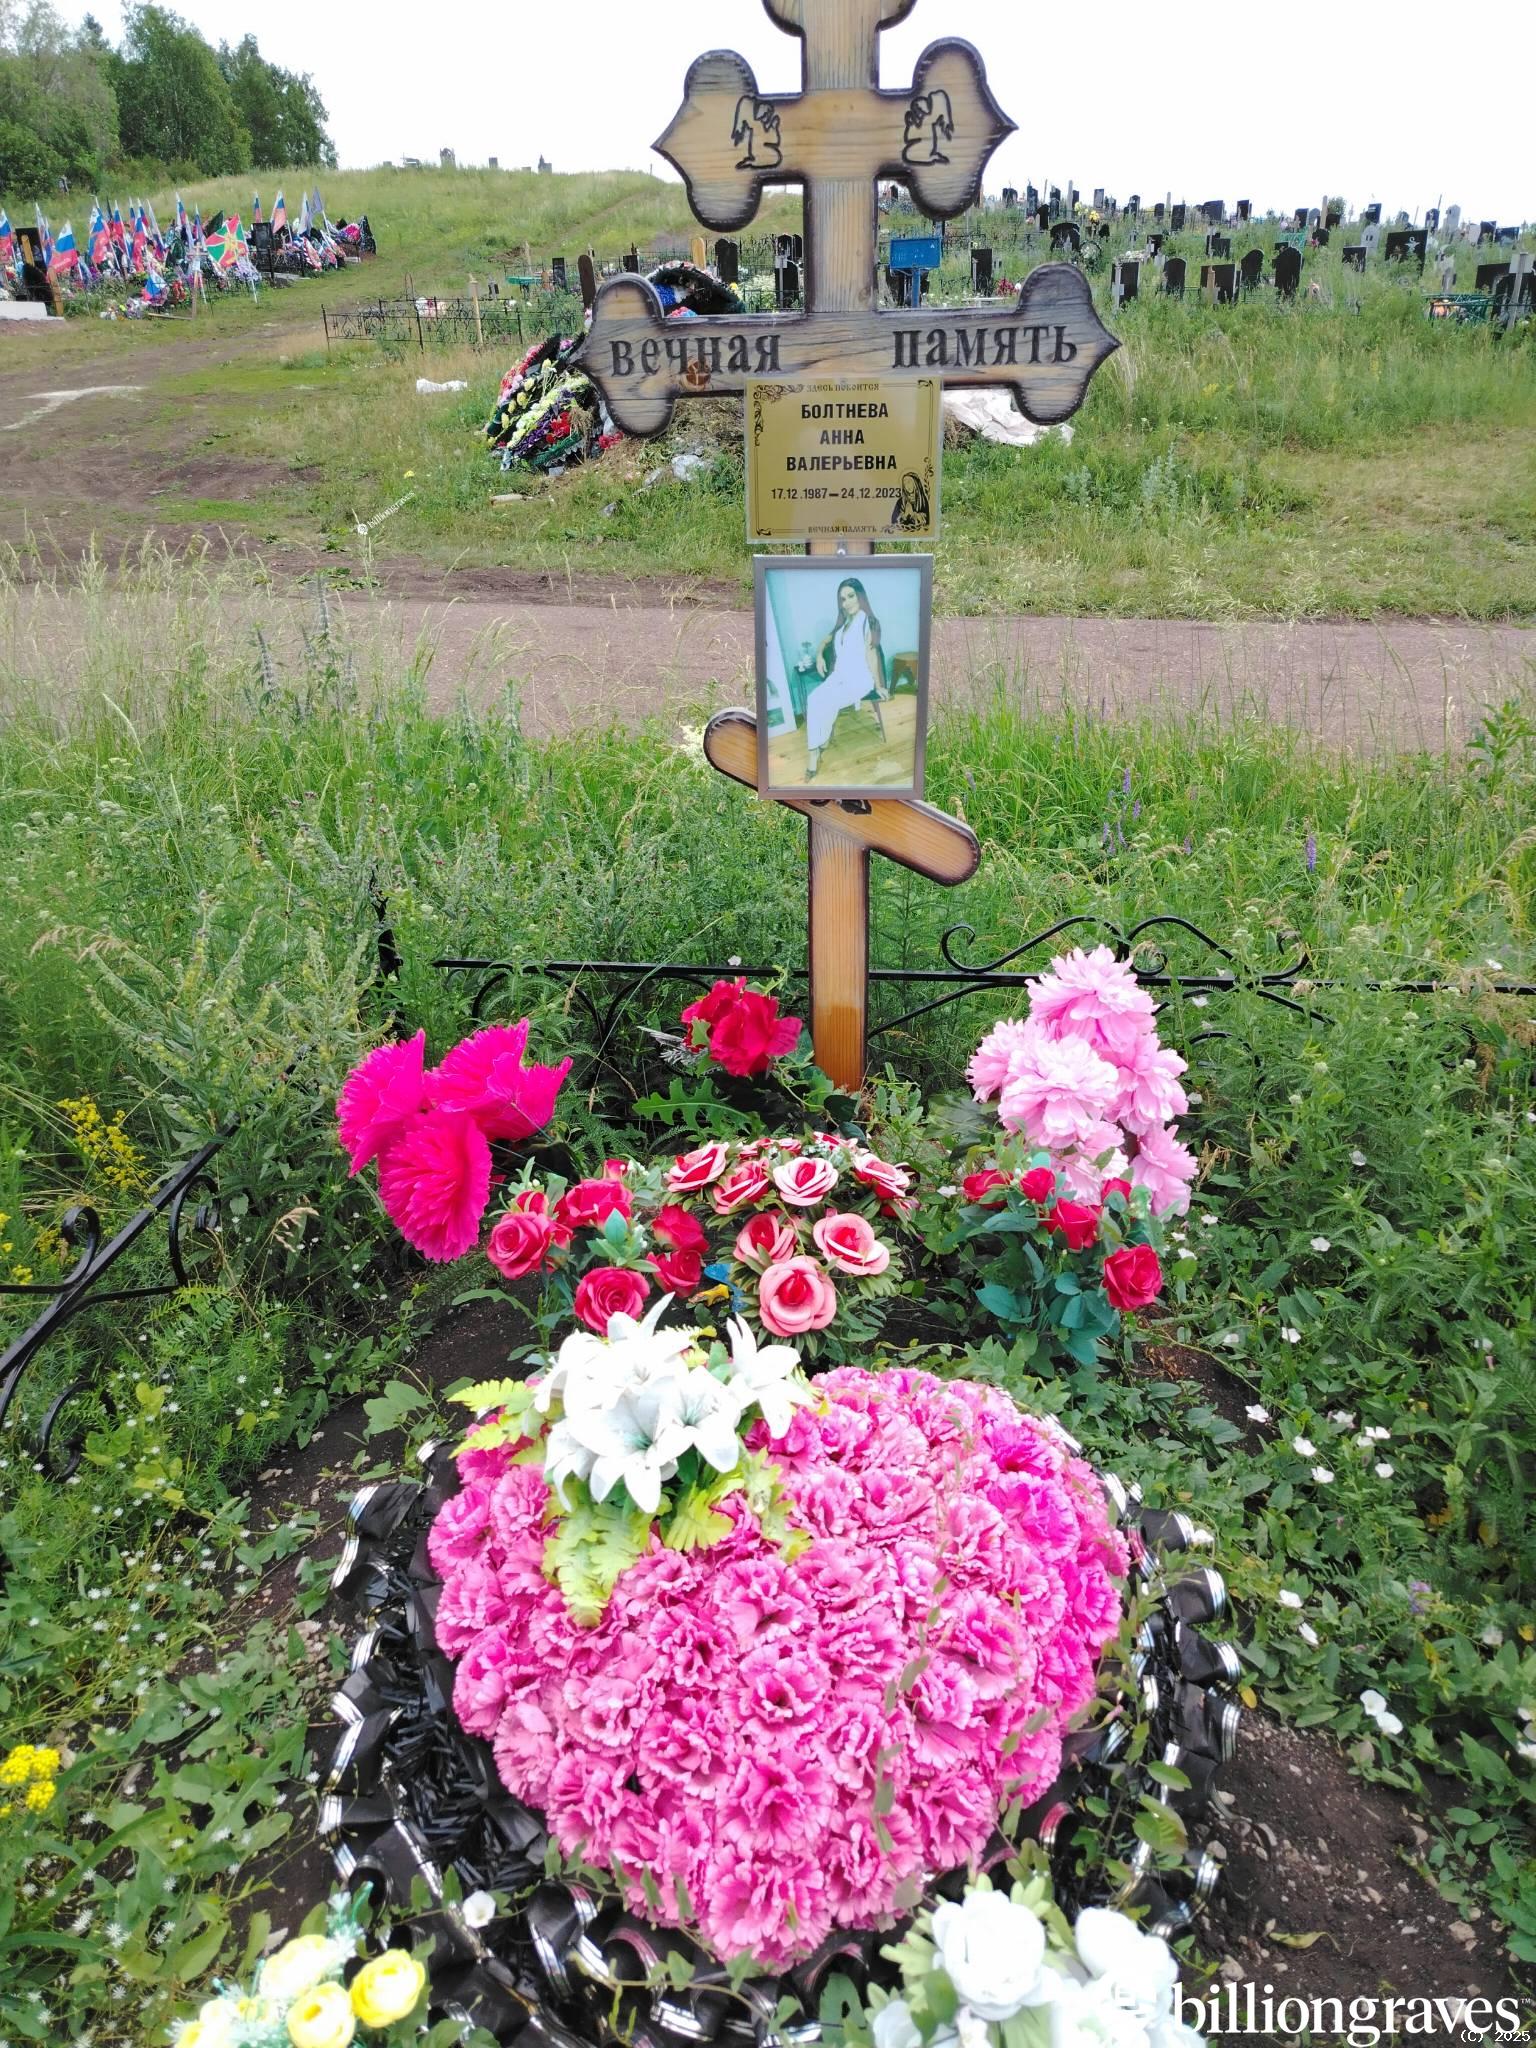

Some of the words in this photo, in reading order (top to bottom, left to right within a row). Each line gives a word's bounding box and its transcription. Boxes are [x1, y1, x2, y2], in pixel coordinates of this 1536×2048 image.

[801, 403, 889, 419] БОЛТНЕВА
[820, 429, 865, 445] АННА
[786, 455, 897, 471] ВАЛЕРЬЕВНА
